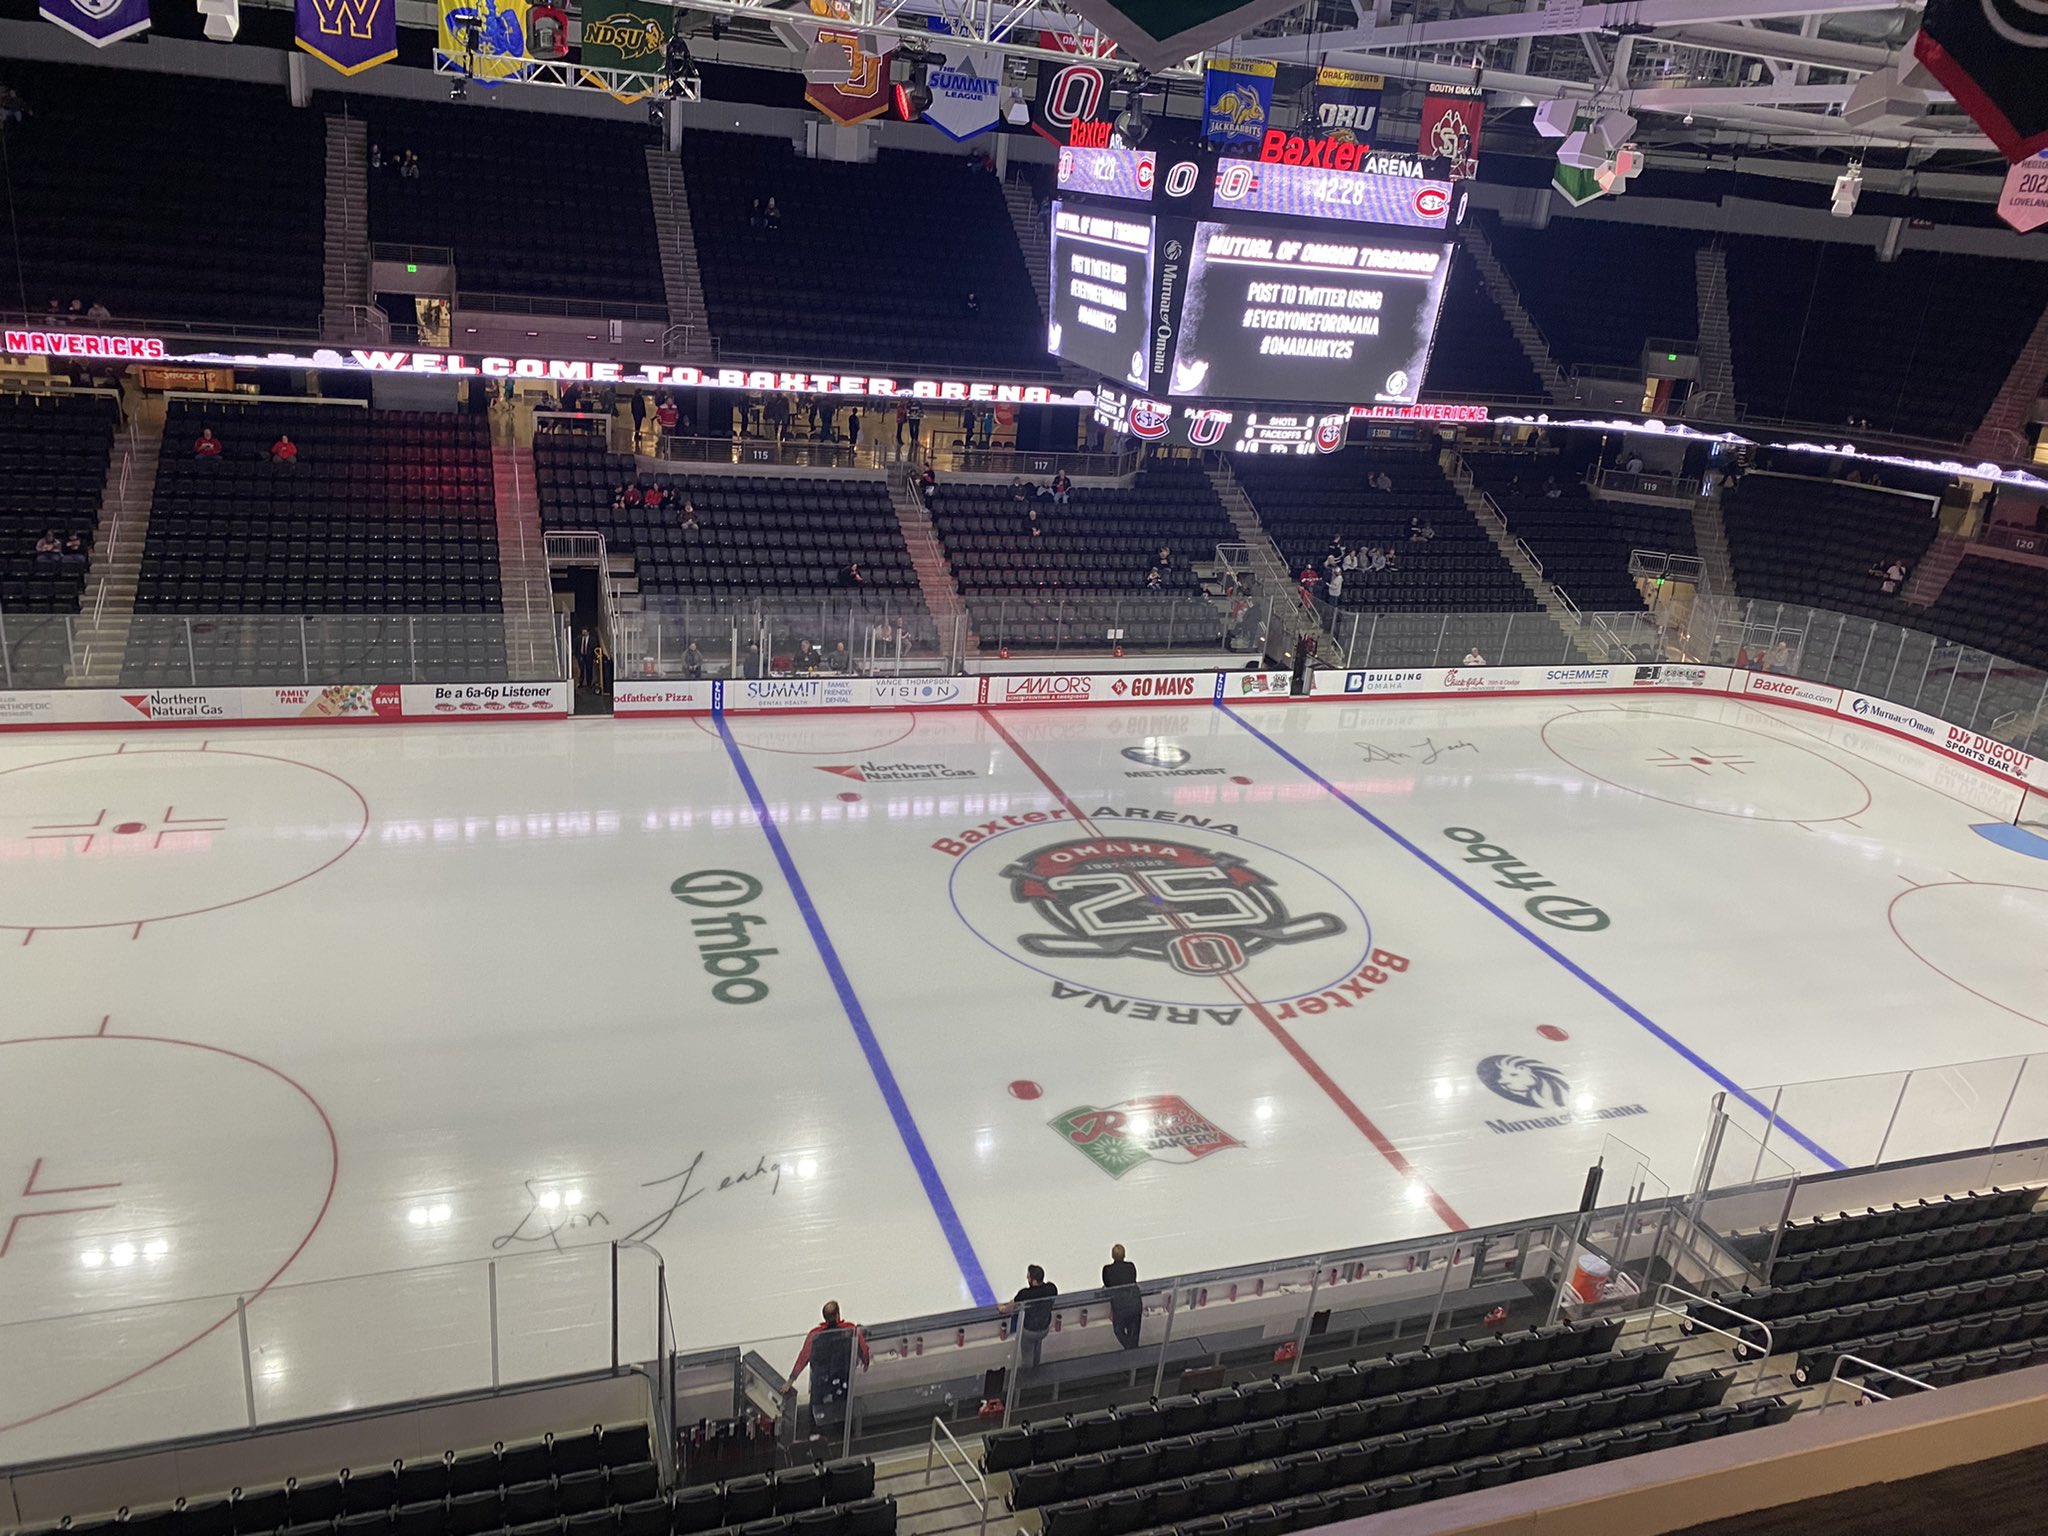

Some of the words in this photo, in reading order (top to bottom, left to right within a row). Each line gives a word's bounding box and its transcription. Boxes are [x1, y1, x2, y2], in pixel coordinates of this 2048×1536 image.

[584, 23, 645, 49] NDSU
[1062, 36, 1096, 48] OMHA
[1231, 62, 1255, 73] STATE
[929, 72, 1000, 96] SUMMIT
[1322, 71, 1343, 80] ORAL
[1344, 73, 1380, 83] ROBERTS
[945, 91, 984, 101] LEAGUE
[1429, 83, 1455, 93] SOUTH
[1319, 103, 1377, 131] ORU
[1070, 117, 1113, 147] Baxter
[1211, 121, 1262, 137] JACKRABBITS
[1260, 129, 1370, 173] Baxter
[1364, 156, 1424, 179] ARENA
[2019, 174, 2048, 193] 202
[1206, 235, 1274, 259] MUTUAL
[1279, 239, 1301, 261] OF
[1300, 243, 1359, 266] OMAHA
[1247, 282, 1280, 304] POST
[1281, 285, 1297, 305] TO
[1298, 286, 1348, 309] TWITTER
[1348, 289, 1384, 311] USING
[1241, 308, 1380, 336] #EVERYONEFOROMAHA
[5, 331, 164, 358] MAVERICKS
[1259, 336, 1355, 360] #OMAHAHKY25
[350, 350, 624, 381] WELCOME
[640, 365, 703, 385] TO
[718, 369, 901, 396] BAXTER
[912, 381, 1052, 403] ARENA
[1269, 416, 1298, 427] SHOTS
[1400, 404, 1489, 422] MAVERICKS
[1260, 429, 1302, 439] FACEOFFS
[752, 450, 769, 460] 115
[1033, 461, 1048, 470] 117
[1642, 482, 1658, 492] 119
[2015, 539, 2034, 550] 120
[1368, 673, 1422, 682] BUILDING
[1546, 669, 1609, 680] SCHEMMER
[435, 687, 452, 699] Be
[455, 689, 463, 698] a
[466, 686, 499, 700] 6a-6p
[502, 686, 552, 698] Listener
[980, 679, 988, 703] CCM
[1006, 677, 1092, 694] LAWLOR'S
[1131, 678, 1153, 697] GO
[1154, 677, 1195, 696] MAVS
[1216, 674, 1225, 699] CCM
[1366, 682, 1402, 690] OMAHA
[151, 690, 207, 705] Northern
[375, 697, 401, 705] SAVE
[613, 693, 663, 704] odfather's
[665, 692, 693, 703] Pizza
[152, 705, 198, 716] Natural
[200, 705, 223, 715] Gas
[1945, 740, 1986, 762] SPORTS
[1987, 757, 2010, 773] BAR
[1947, 726, 1971, 744] DJ's
[1973, 735, 2034, 770] DUGOUT
[860, 762, 946, 772] Northern
[865, 770, 935, 780] Natural
[941, 769, 976, 777] Gas
[1124, 768, 1227, 778] METHODIST
[931, 808, 1069, 858] Baxter
[1090, 806, 1240, 837] ARENA
[1050, 843, 1179, 863] OMAHA
[1048, 866, 1268, 936] 25
[1274, 947, 1411, 1020] Baxter
[1050, 981, 1242, 1026] ARENA
[1150, 1123, 1210, 1138] ALIAN
